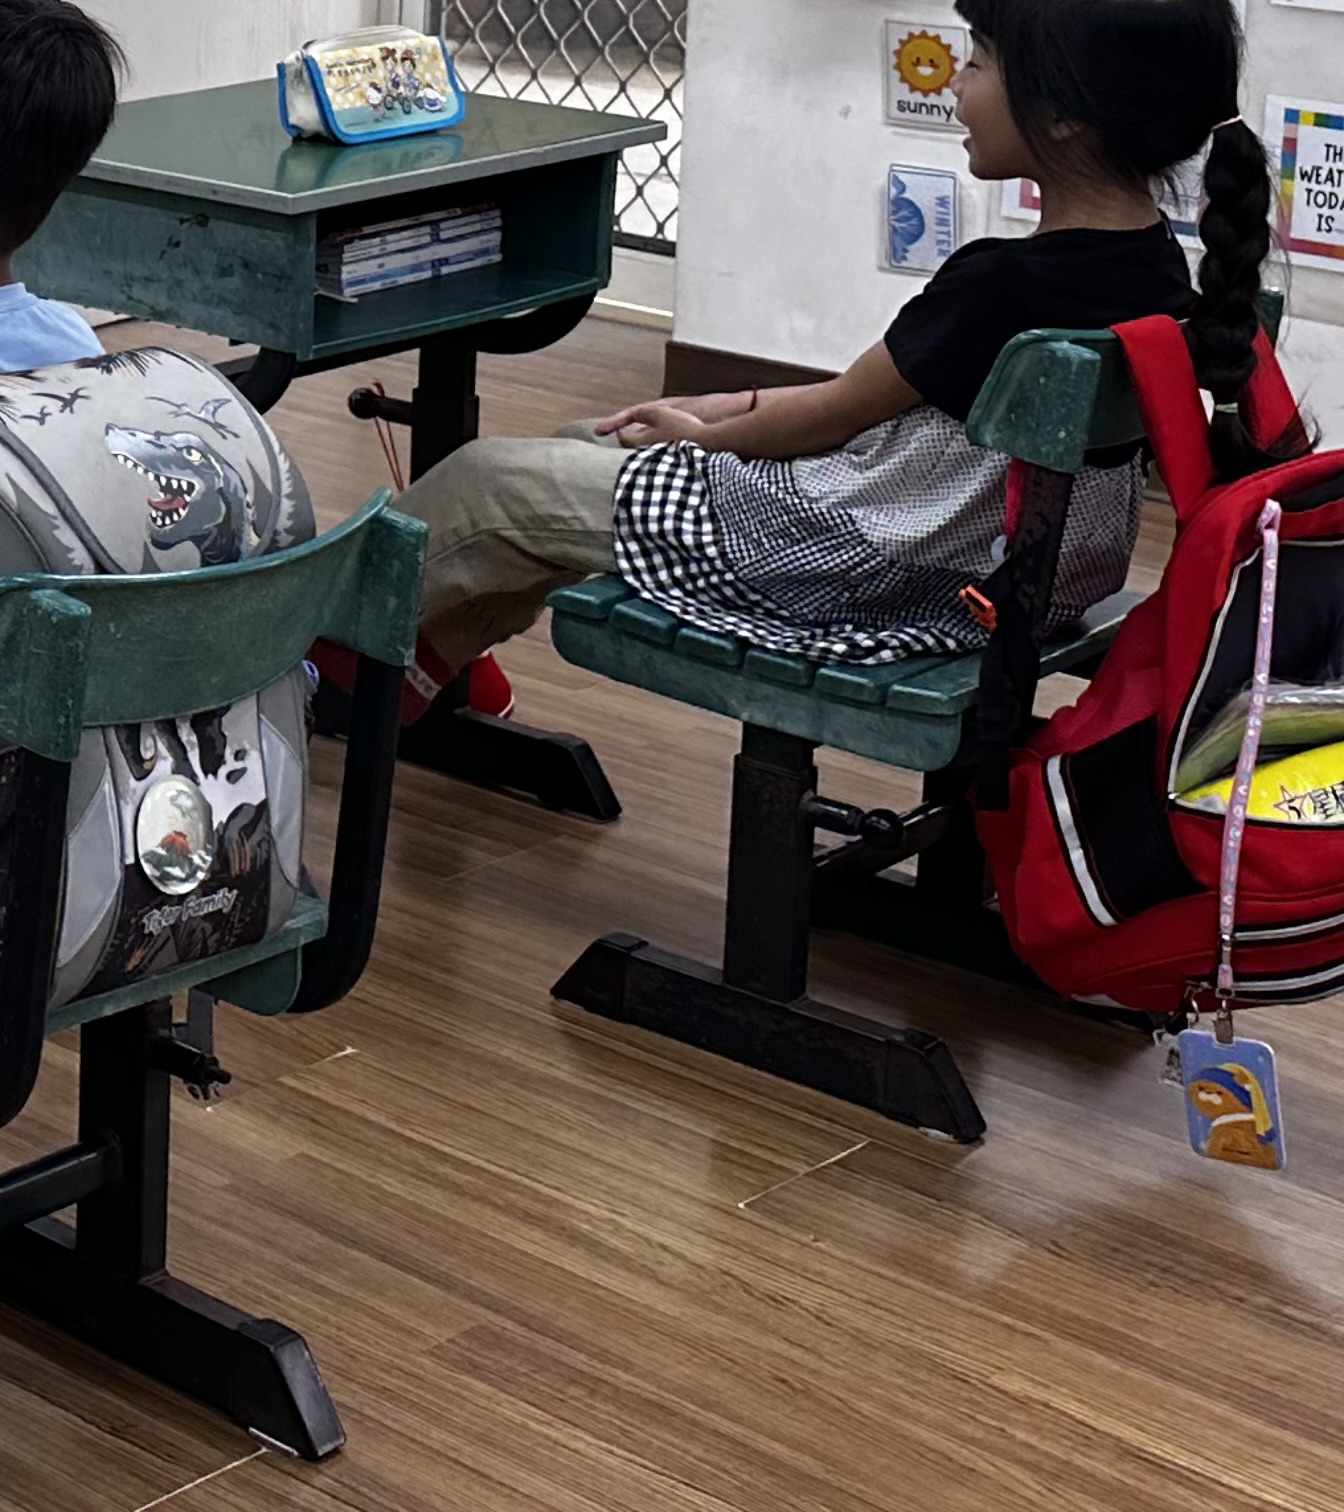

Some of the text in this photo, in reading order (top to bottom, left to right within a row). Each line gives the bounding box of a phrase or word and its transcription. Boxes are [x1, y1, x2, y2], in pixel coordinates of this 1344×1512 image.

[896, 99, 954, 123] sunny
[933, 194, 952, 258] WINTER
[1316, 213, 1335, 233] IS
